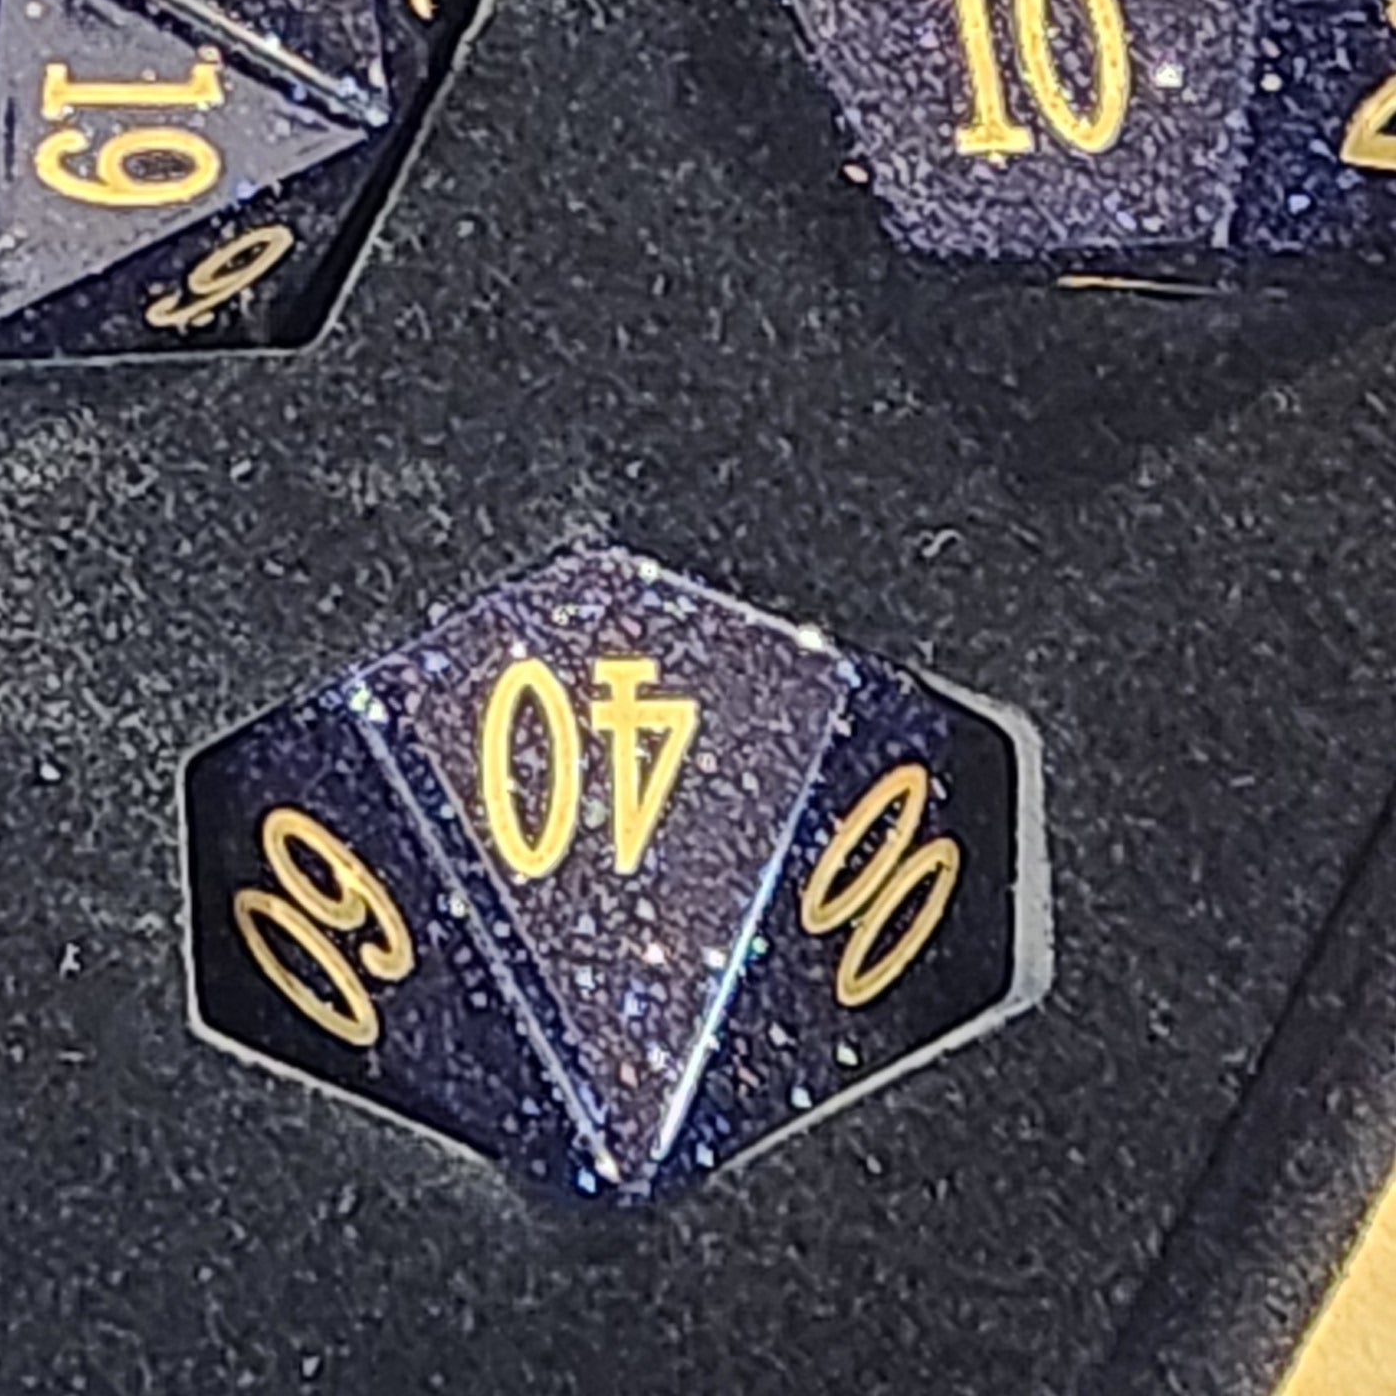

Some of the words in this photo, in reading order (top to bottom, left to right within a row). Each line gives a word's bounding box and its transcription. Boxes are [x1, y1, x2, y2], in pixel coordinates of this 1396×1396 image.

[35, 64, 224, 206] 19
[481, 657, 698, 879] 40
[802, 764, 961, 1007] 00
